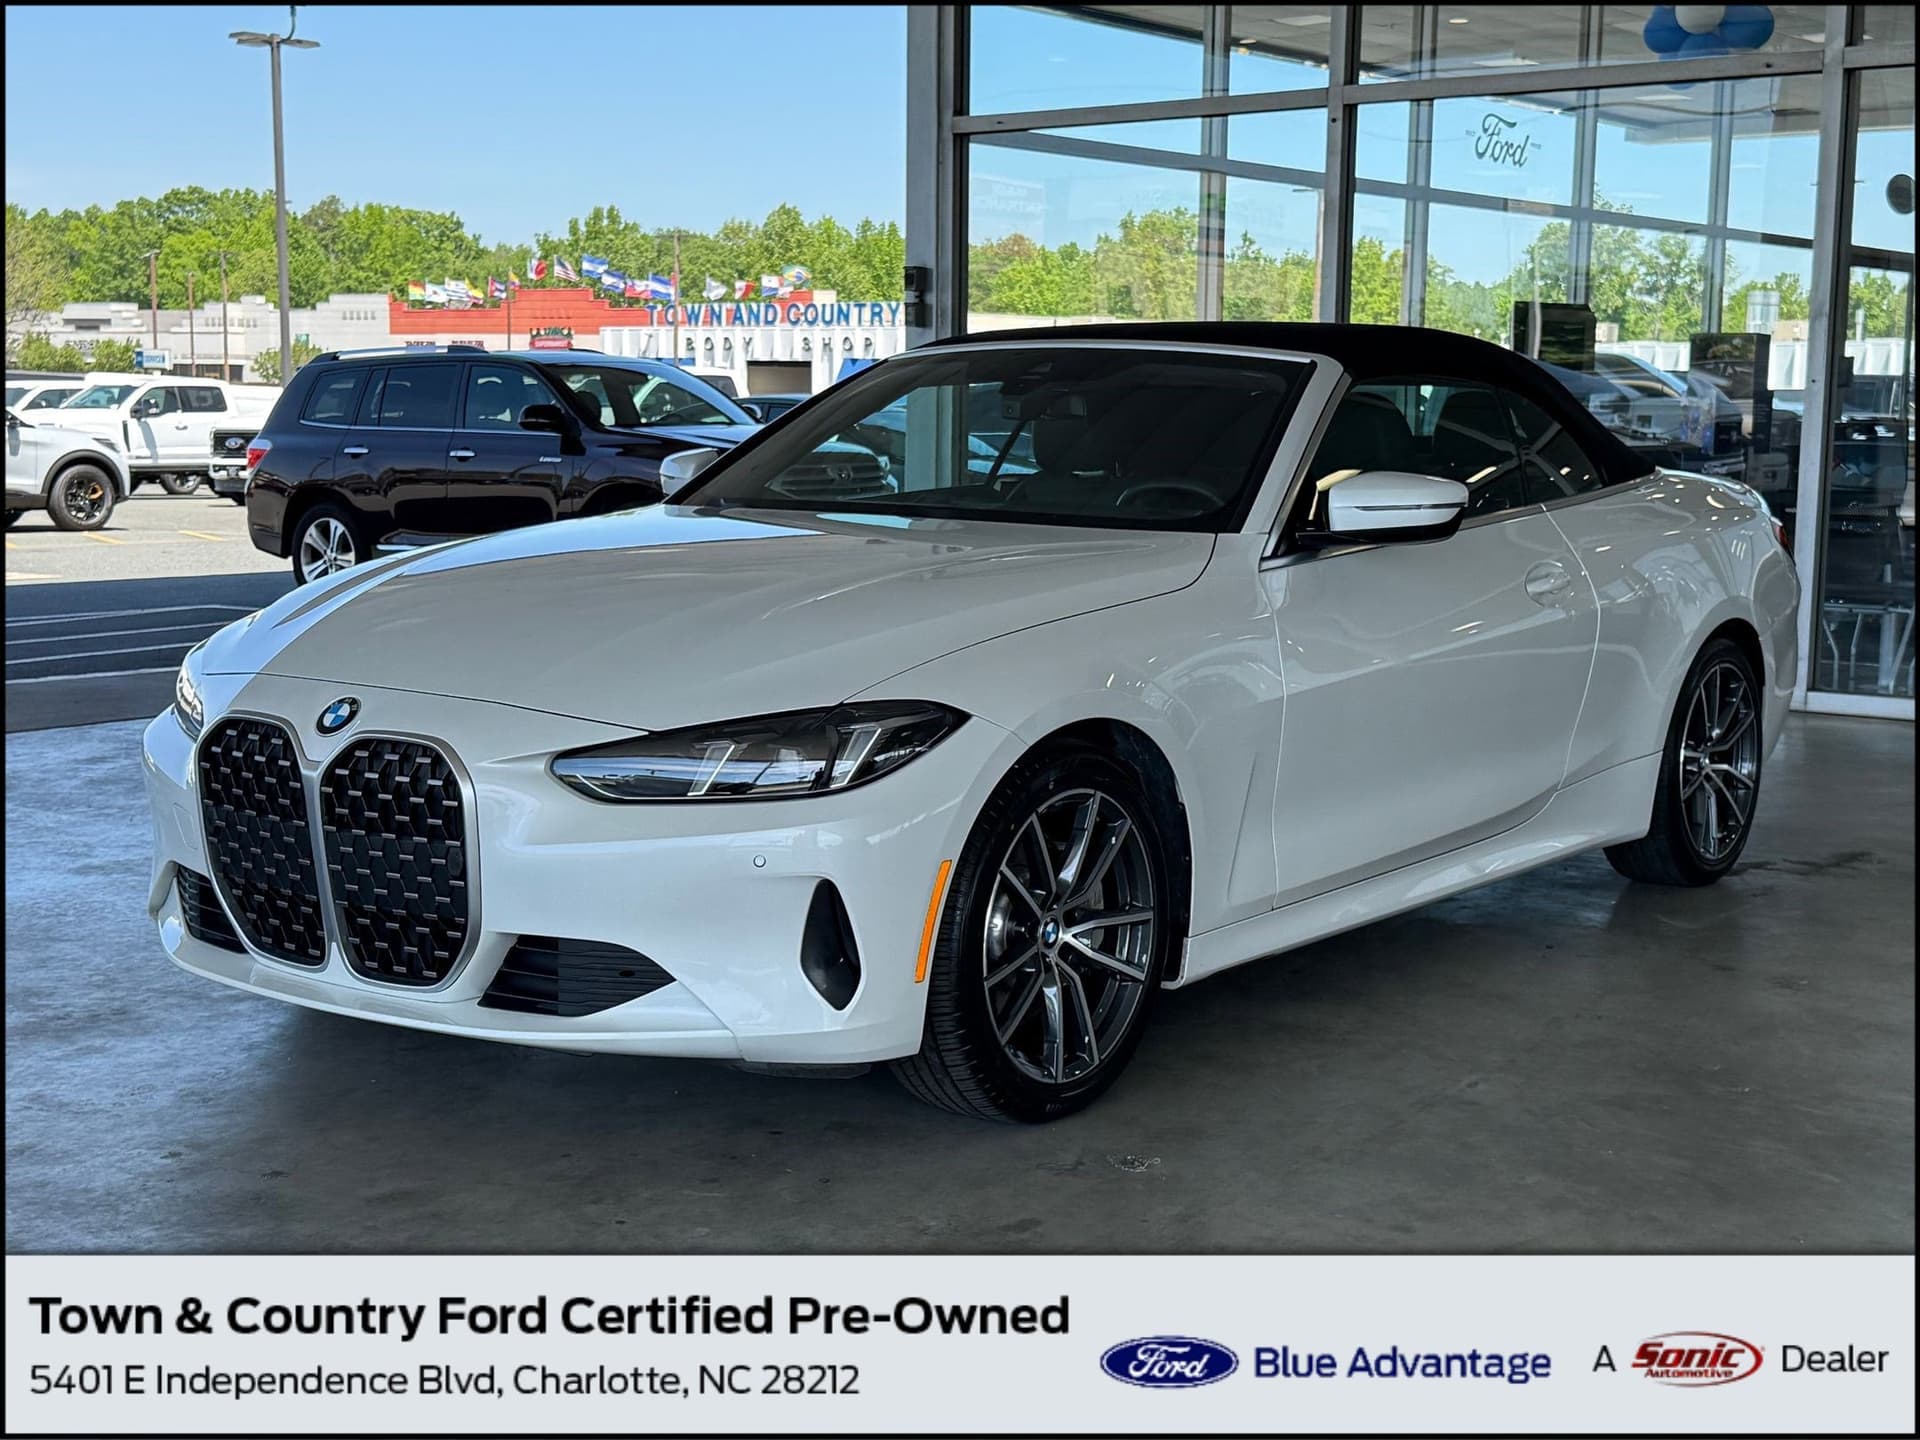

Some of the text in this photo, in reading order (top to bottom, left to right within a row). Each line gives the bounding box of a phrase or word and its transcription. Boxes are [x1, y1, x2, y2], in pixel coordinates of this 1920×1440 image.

[1475, 113, 1530, 168] Ford
[644, 302, 902, 327] TOWN AND COUNTRY
[685, 336, 874, 352] BODY SHOP
